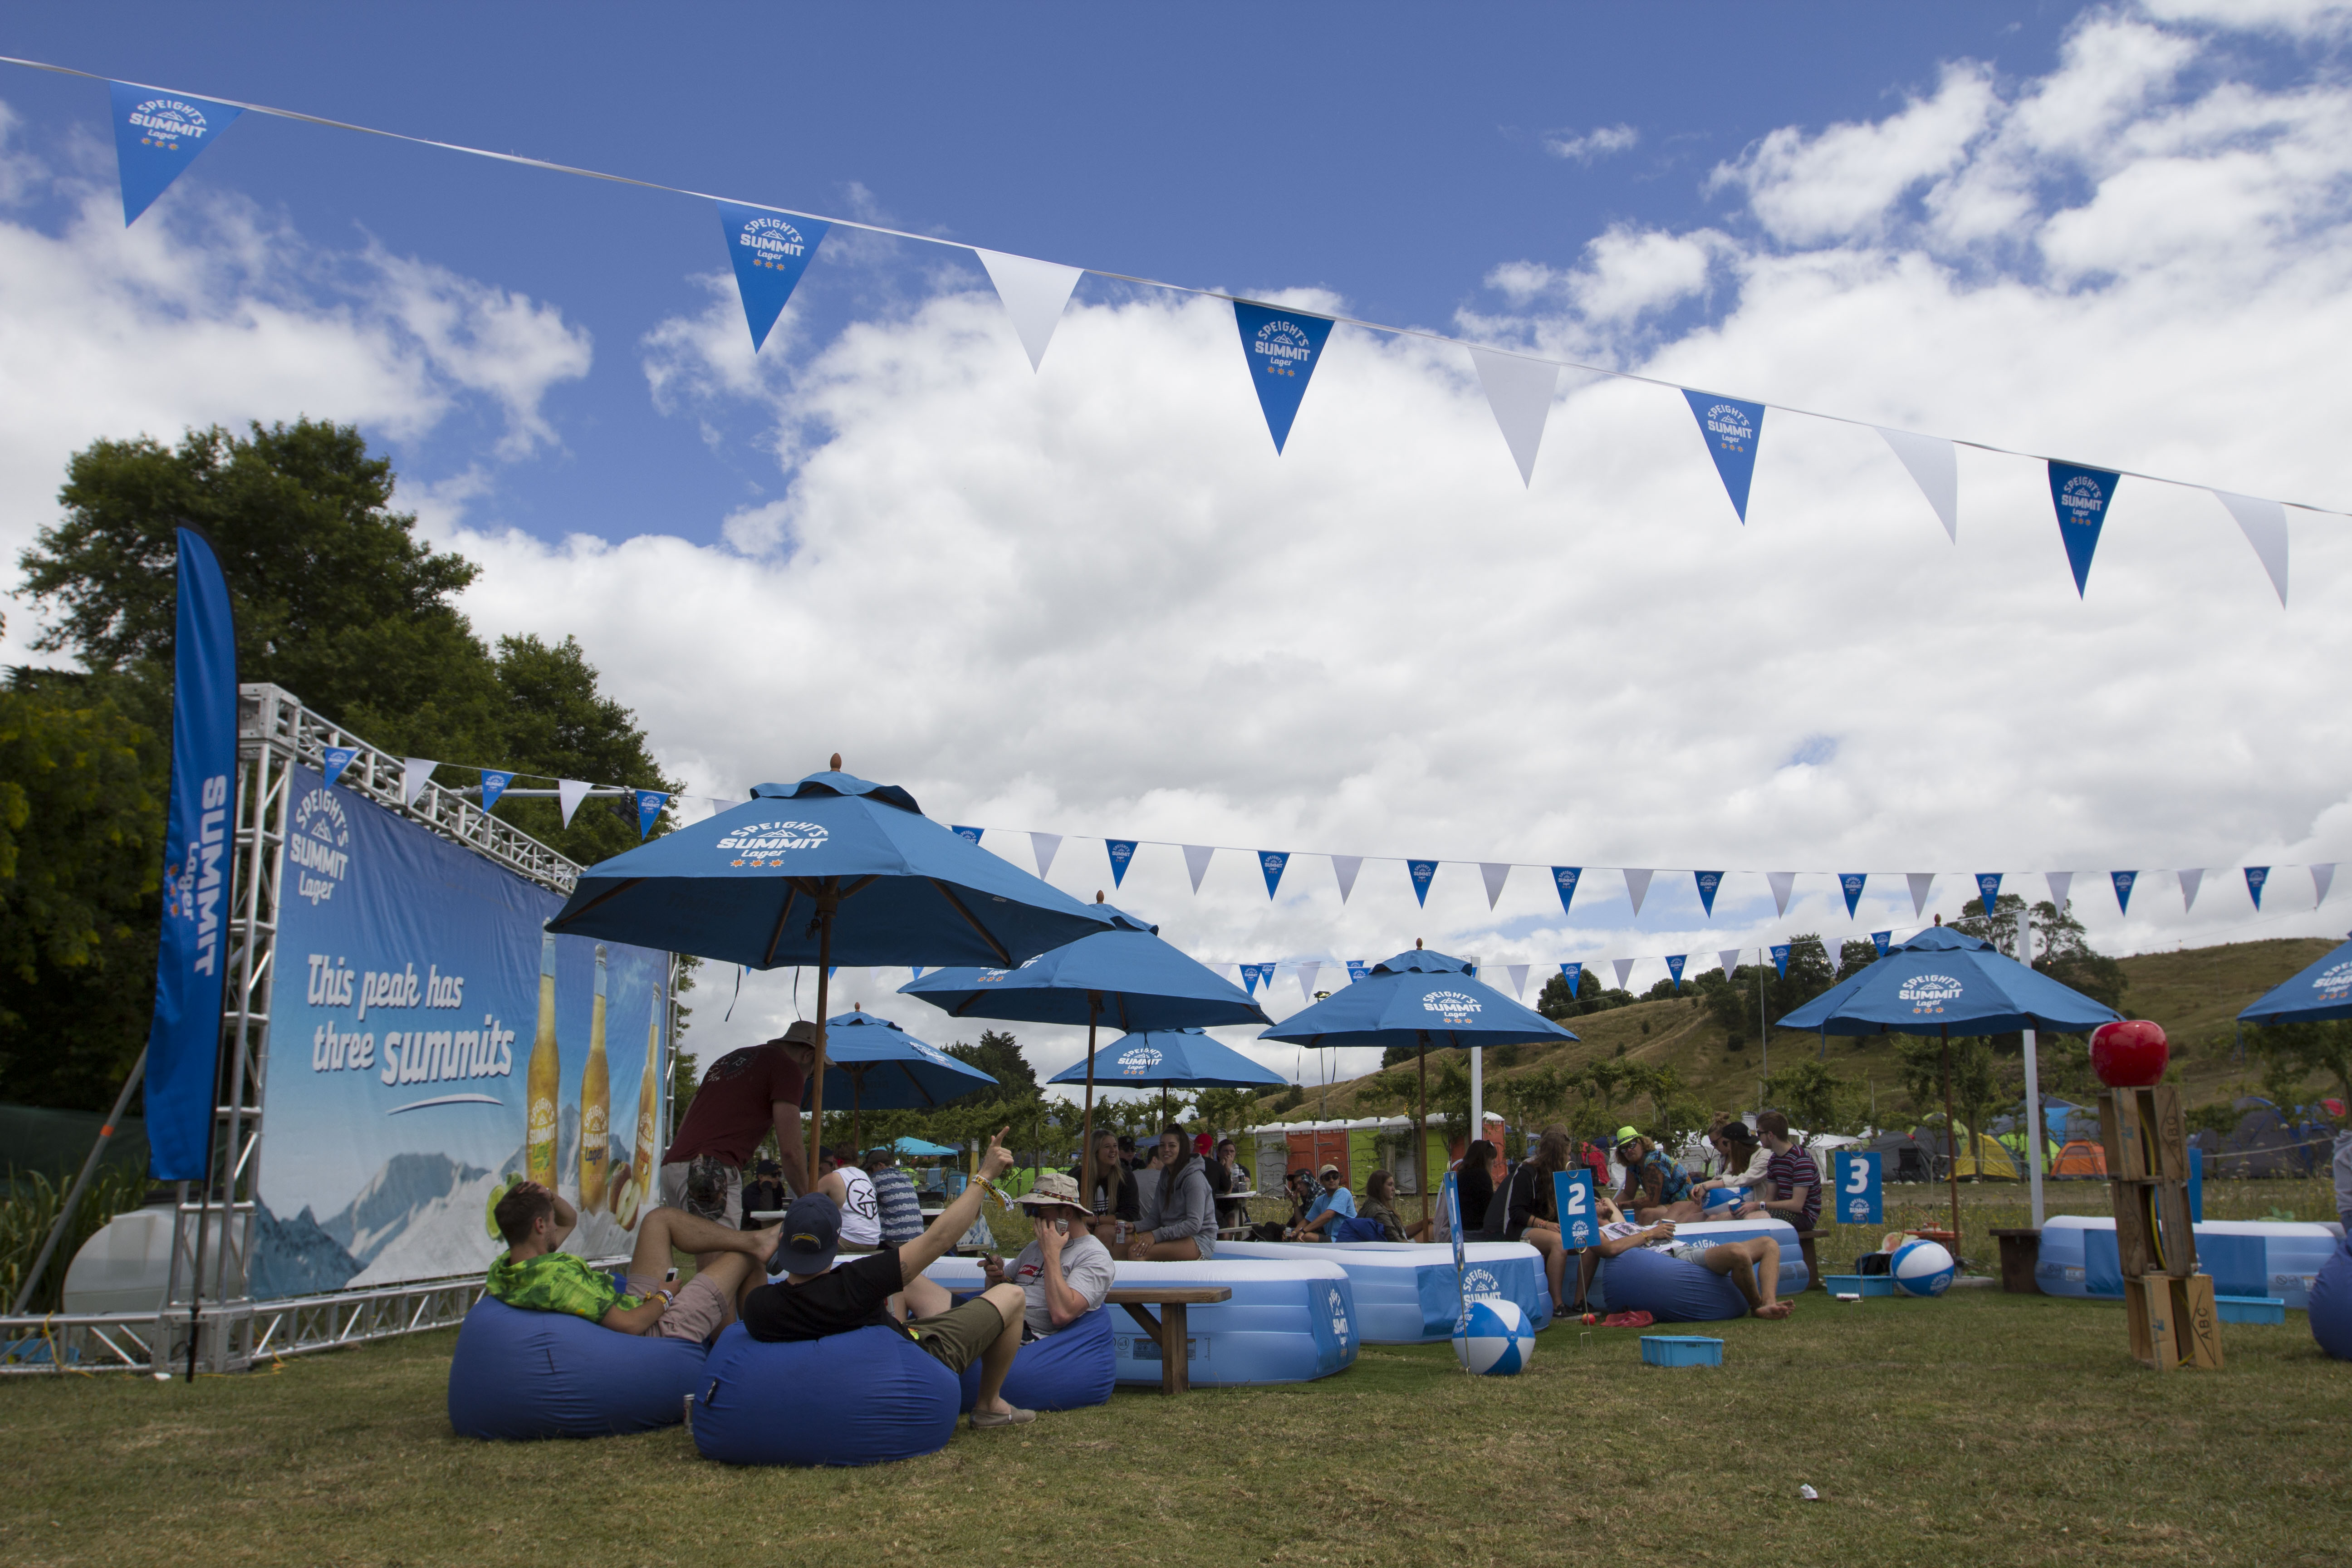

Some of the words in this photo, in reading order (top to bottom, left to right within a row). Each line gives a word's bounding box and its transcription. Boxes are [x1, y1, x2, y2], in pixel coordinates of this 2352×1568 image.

[137, 99, 206, 125] SPEIGHT'S
[129, 113, 207, 138] SUMMIT
[147, 129, 179, 140] Lager
[744, 218, 803, 243] SPEIGHT'S
[740, 233, 804, 256] SUMMIT
[757, 250, 783, 260] Lager
[1258, 321, 1309, 347] SPEIGHT'S
[1255, 341, 1311, 361] SUMMIT
[1270, 357, 1292, 367] Lager
[1708, 405, 1750, 426] SPEIGHT'S
[1708, 420, 1752, 439] SUMMIT
[1722, 434, 1740, 443] Lager
[2063, 476, 2102, 498] SPEIGHT'S
[2061, 494, 2102, 511] SUMMIT
[2073, 508, 2089, 517] Lager
[296, 788, 349, 847] SPEIGHT'S
[730, 822, 829, 837] SPEIGHT'S
[716, 838, 829, 849] SUMMIT
[290, 833, 348, 881] SUMMIT
[741, 850, 786, 859] Lager
[178, 842, 200, 921] Lager
[194, 774, 227, 977] SUMMIT
[299, 870, 335, 906] Lager
[307, 954, 355, 1005] This
[358, 962, 421, 1021] peak
[425, 965, 464, 1008] has
[1902, 975, 1962, 989] SPEIGHT'S
[1423, 991, 1479, 1004] SPEIGHT'S
[1899, 989, 1963, 1000] SUMMIT
[1916, 999, 1942, 1008] Lager
[1423, 1003, 1482, 1012] SUMMIT
[313, 1021, 375, 1072] three
[381, 1014, 515, 1086] summits
[1123, 1048, 1162, 1058] SPEIGHT'S
[529, 1123, 555, 1145] SUMMIT
[583, 1132, 608, 1147] SUMMIT
[585, 1147, 604, 1166] Lager
[1846, 1158, 1870, 1194] 3
[1450, 1188, 1457, 1225] 1
[1568, 1183, 1586, 1215] 2
[1463, 1269, 1499, 1292] SPEIGHT'S
[2197, 1308, 2212, 1340] ABC
